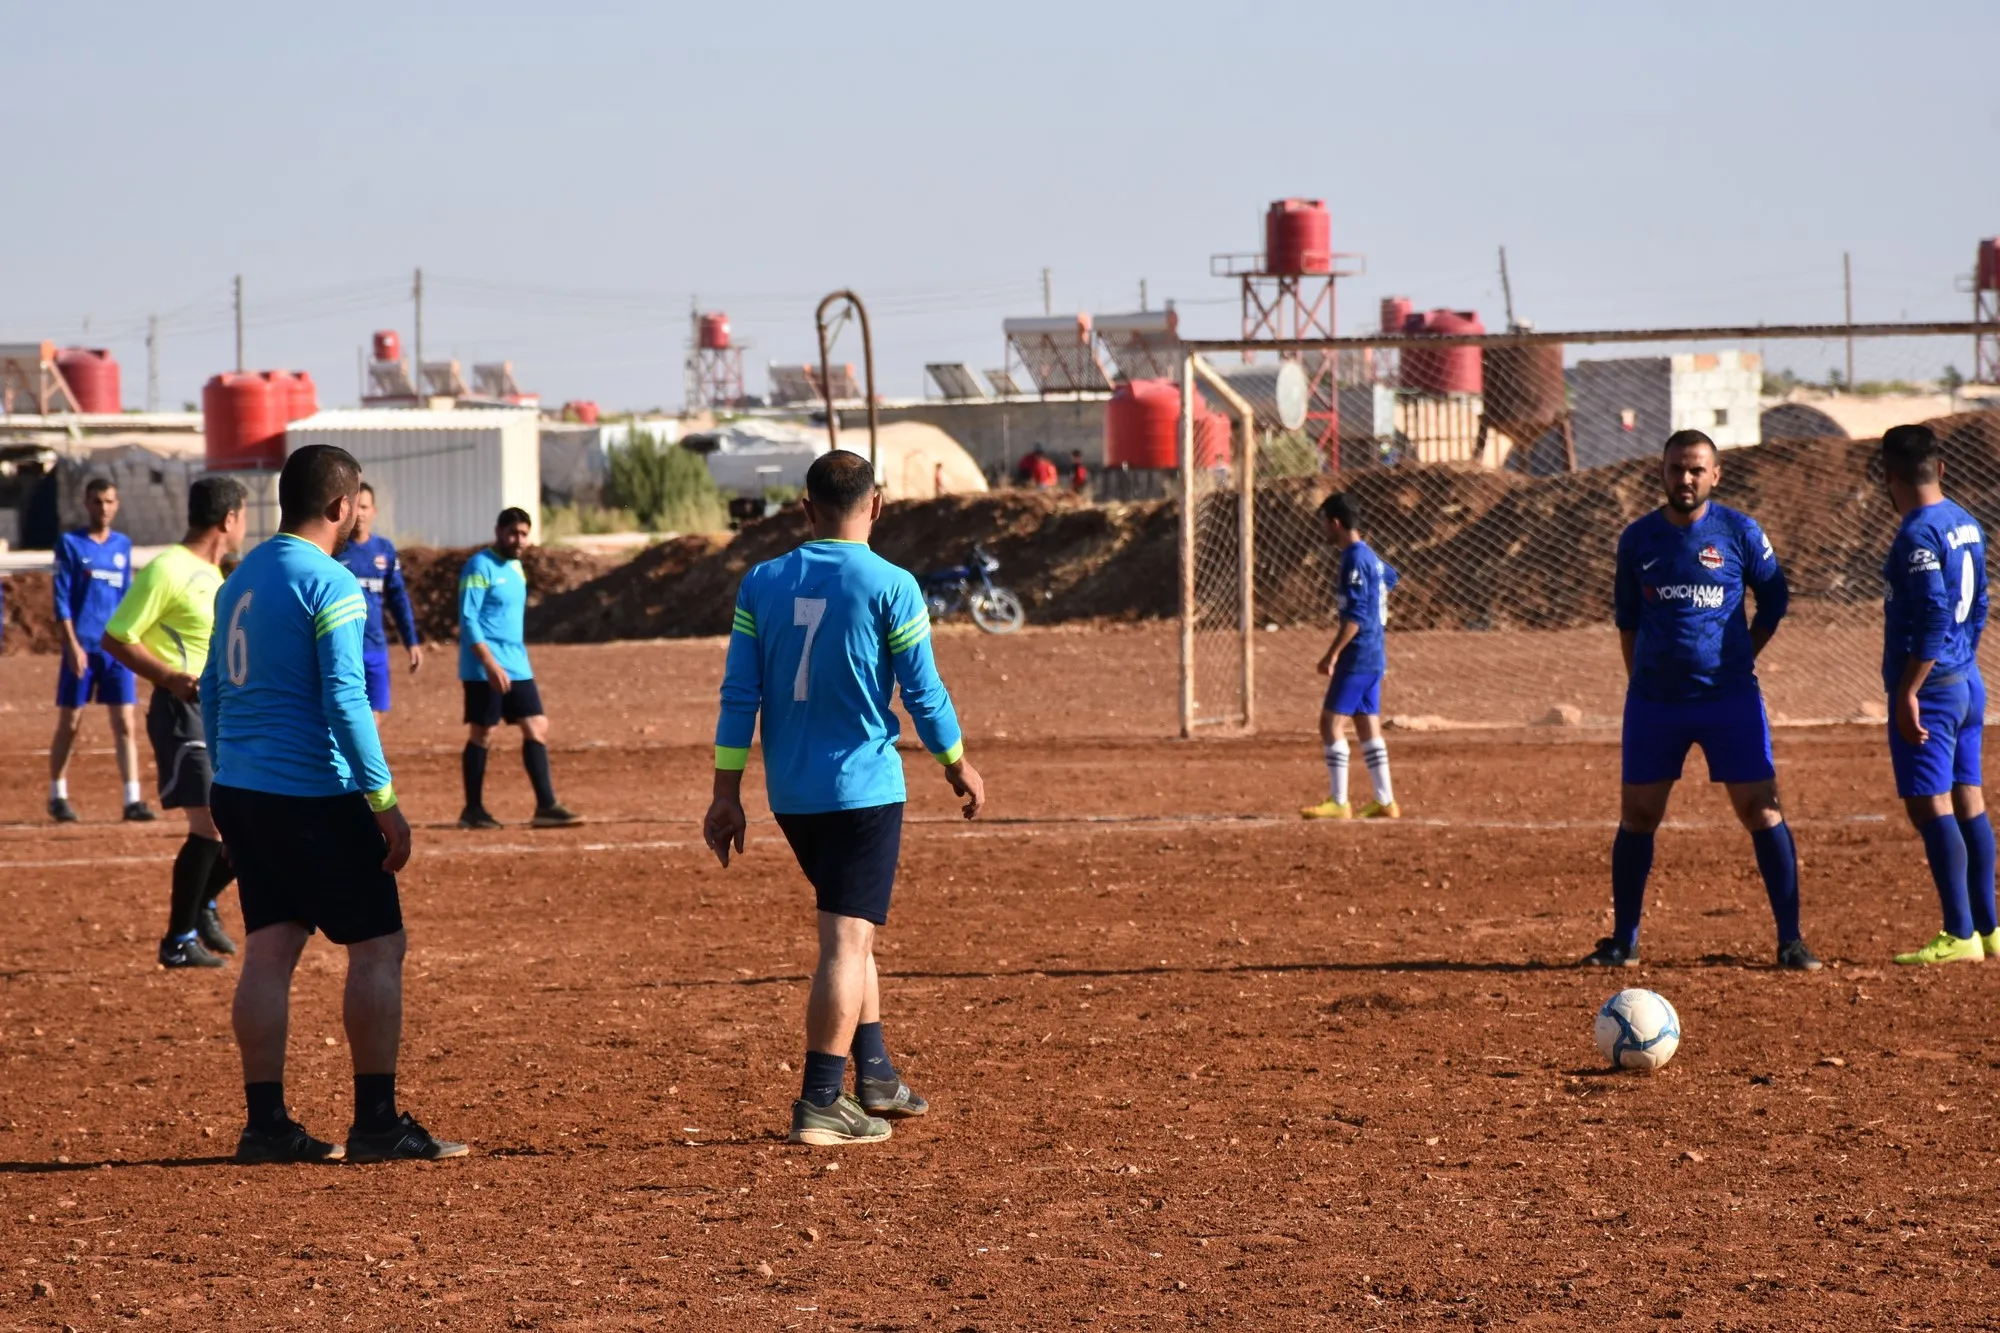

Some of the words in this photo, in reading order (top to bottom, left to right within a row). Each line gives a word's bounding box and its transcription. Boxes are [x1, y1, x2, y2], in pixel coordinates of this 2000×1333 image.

[227, 590, 253, 687] 6
[1656, 584, 1724, 600] YOKOHAMA
[794, 597, 827, 701] 7
